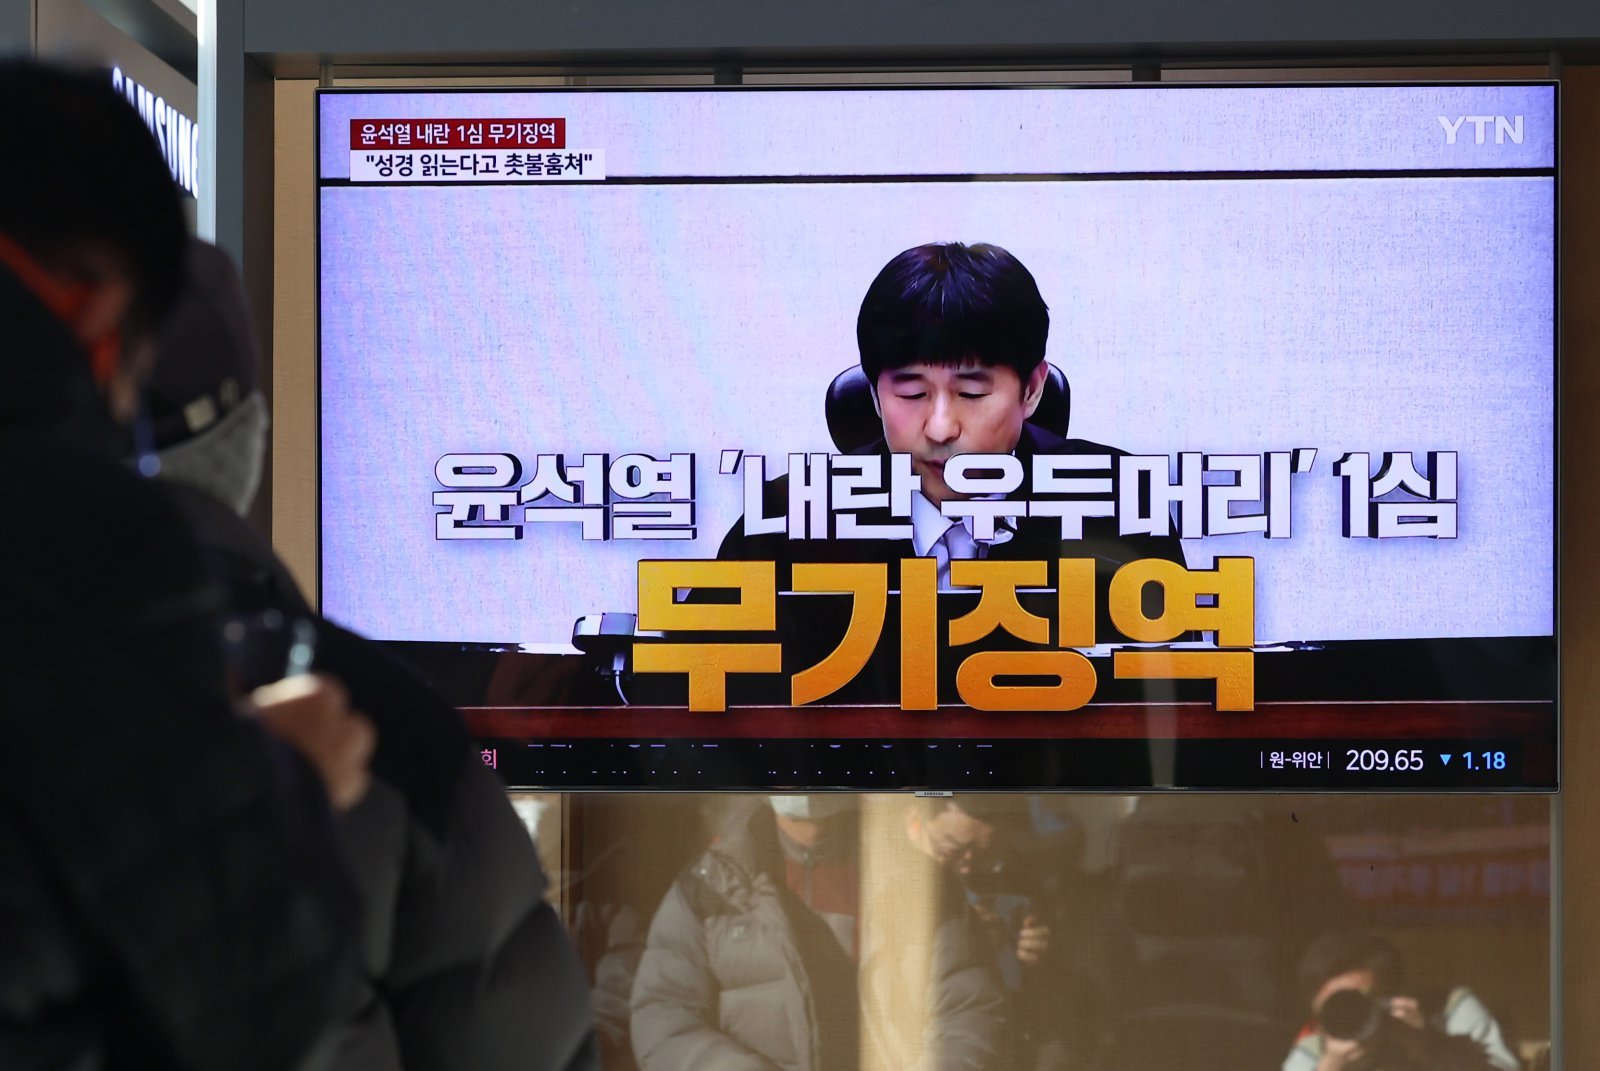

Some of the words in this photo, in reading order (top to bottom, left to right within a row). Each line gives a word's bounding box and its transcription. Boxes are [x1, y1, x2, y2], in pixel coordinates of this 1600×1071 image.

[360, 123, 412, 145] 윤석열
[416, 123, 451, 145] 내란
[457, 123, 484, 145] 1심
[488, 122, 556, 145] 무기징역
[1437, 115, 1524, 145] YTN
[366, 154, 414, 176] "성경
[420, 154, 500, 176] 읽는다고
[504, 153, 593, 176] 촛불훔쳐"
[432, 452, 697, 541] 윤석열
[719, 448, 923, 540] '내란
[940, 448, 1318, 540] 우두머리'
[1333, 450, 1459, 540] 1심
[632, 556, 1255, 712] 무기징역
[1345, 749, 1424, 771] 209.65
[1462, 751, 1506, 770] 1.18
